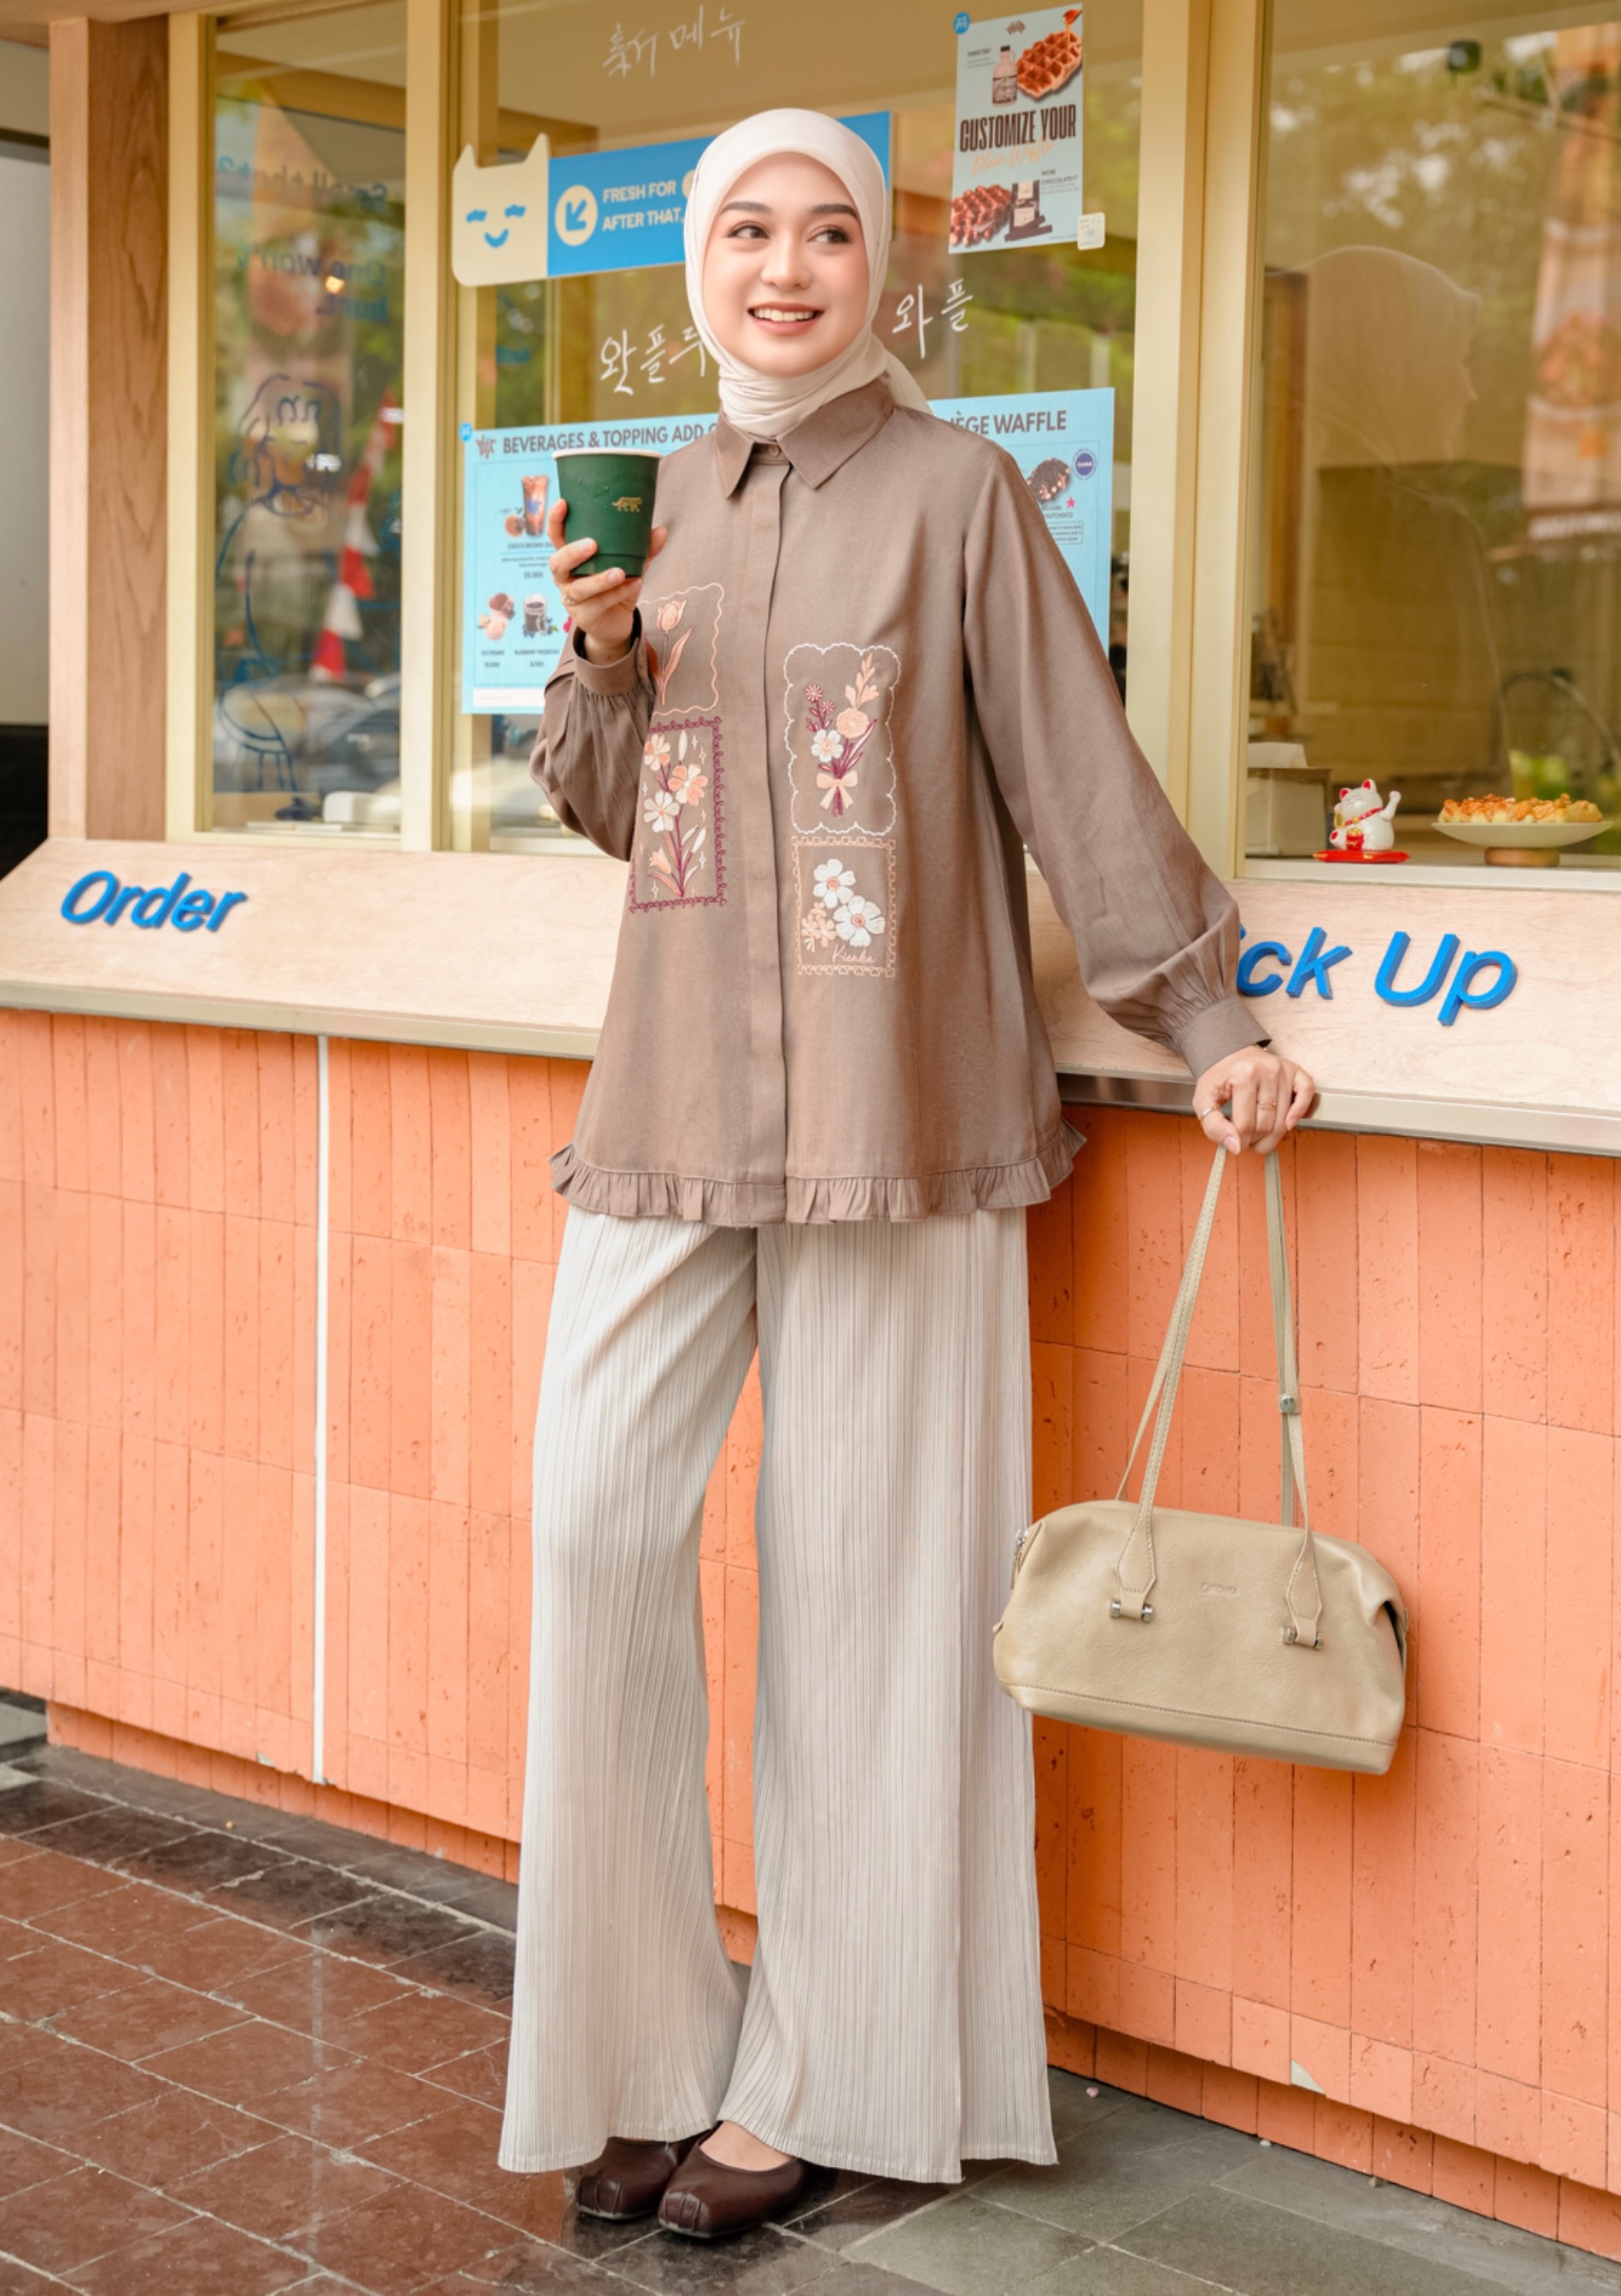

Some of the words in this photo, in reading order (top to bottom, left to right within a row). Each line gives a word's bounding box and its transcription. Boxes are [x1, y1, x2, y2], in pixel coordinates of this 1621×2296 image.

[959, 110, 1037, 152] CUSTOMIZE
[1040, 104, 1077, 142] YOUR
[603, 184, 646, 203] FRESH
[649, 179, 676, 197] FOR
[602, 212, 644, 231] AFTER
[892, 278, 974, 360] 와플
[503, 431, 584, 454] BEVERAGES
[589, 430, 600, 448] &
[603, 426, 668, 448] TOPPING
[672, 424, 704, 442] ADD
[993, 410, 1067, 434] WAFFLE
[61, 870, 249, 933] Order
[1236, 923, 1353, 1000] ck
[1374, 931, 1518, 1027] Up
